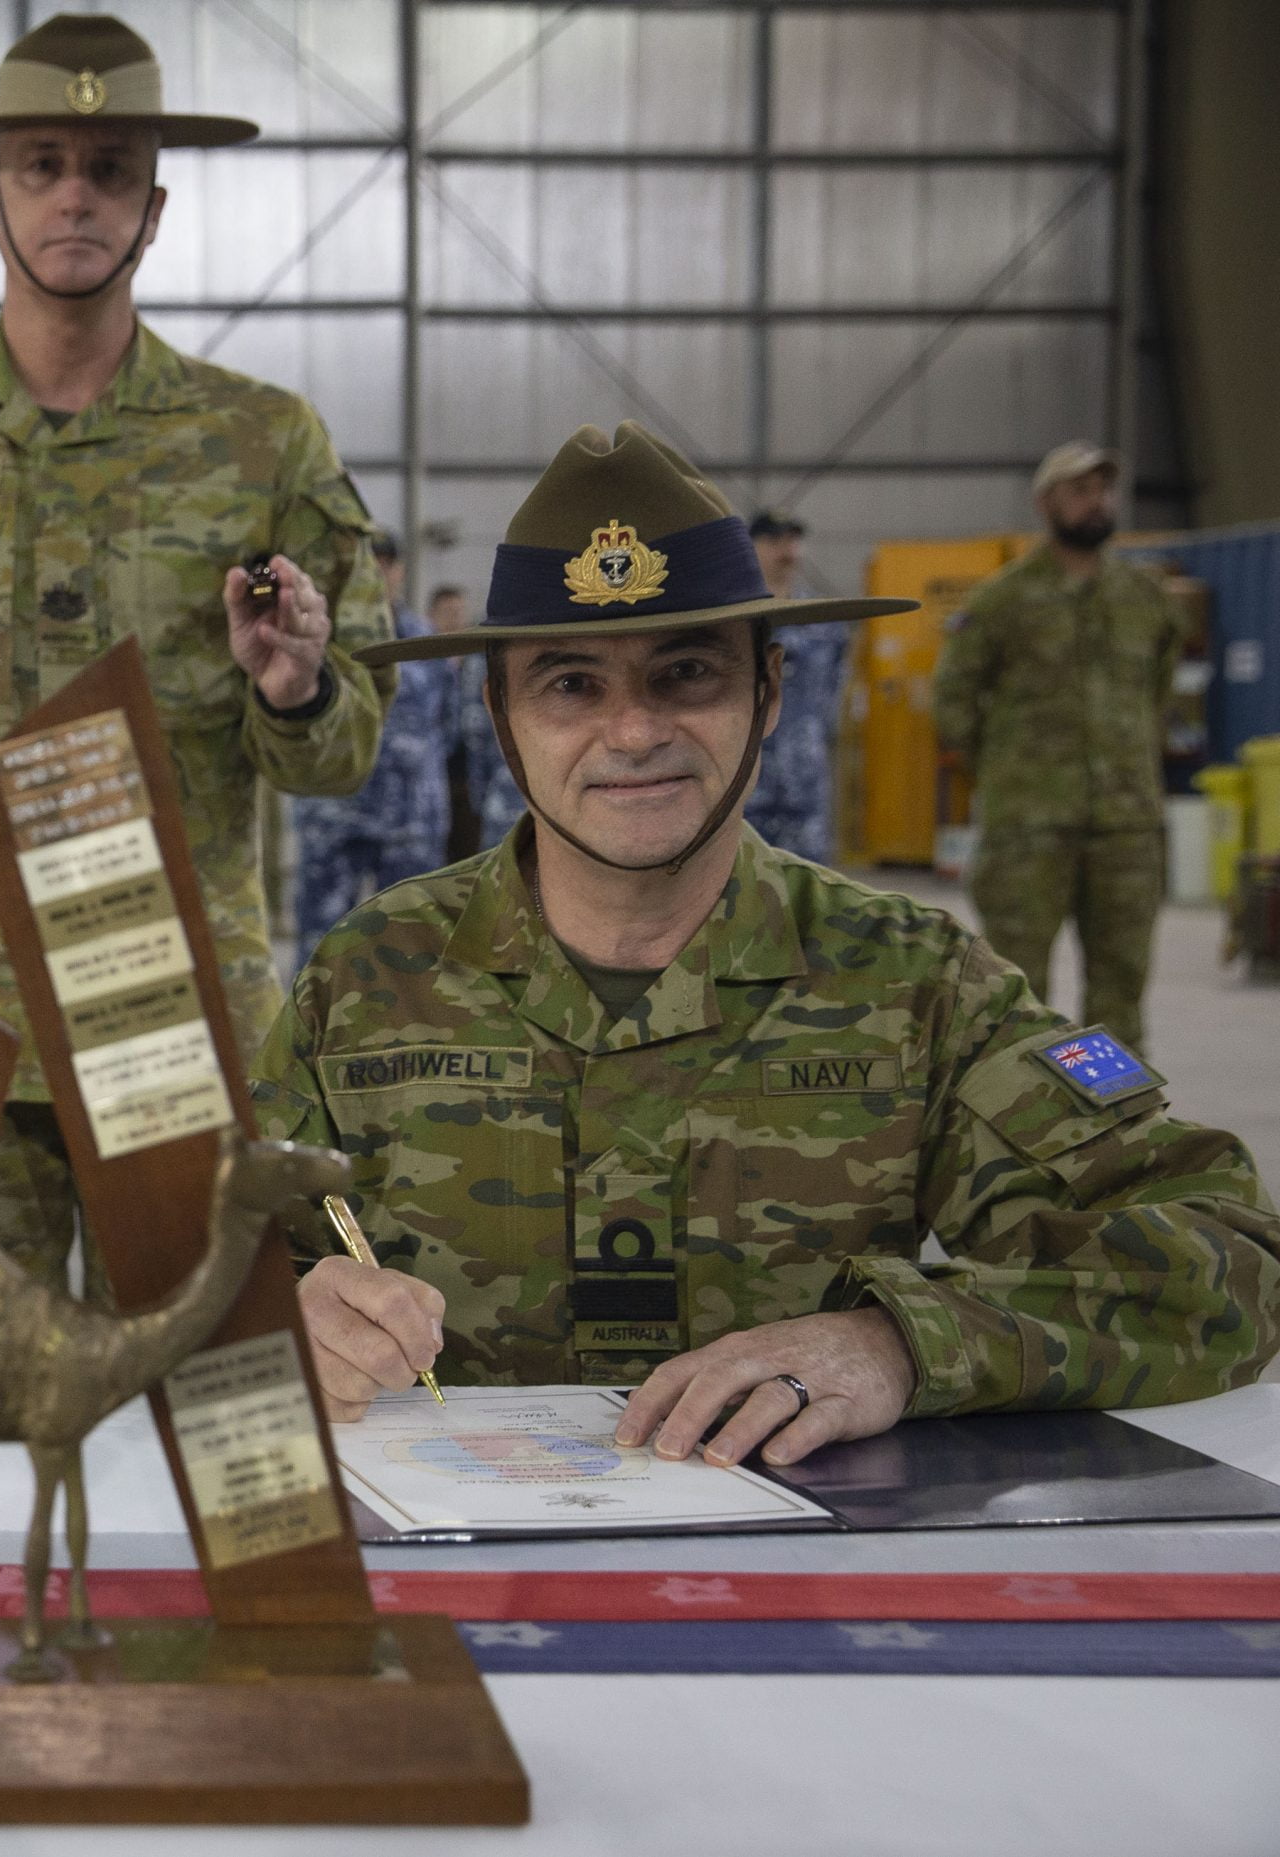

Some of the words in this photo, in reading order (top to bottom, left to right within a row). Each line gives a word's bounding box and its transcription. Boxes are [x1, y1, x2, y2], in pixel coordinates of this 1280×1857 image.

[347, 1052, 502, 1087] ROTHWELL
[790, 1062, 873, 1088] NAVY
[592, 1327, 670, 1341] AUSTRALIA
